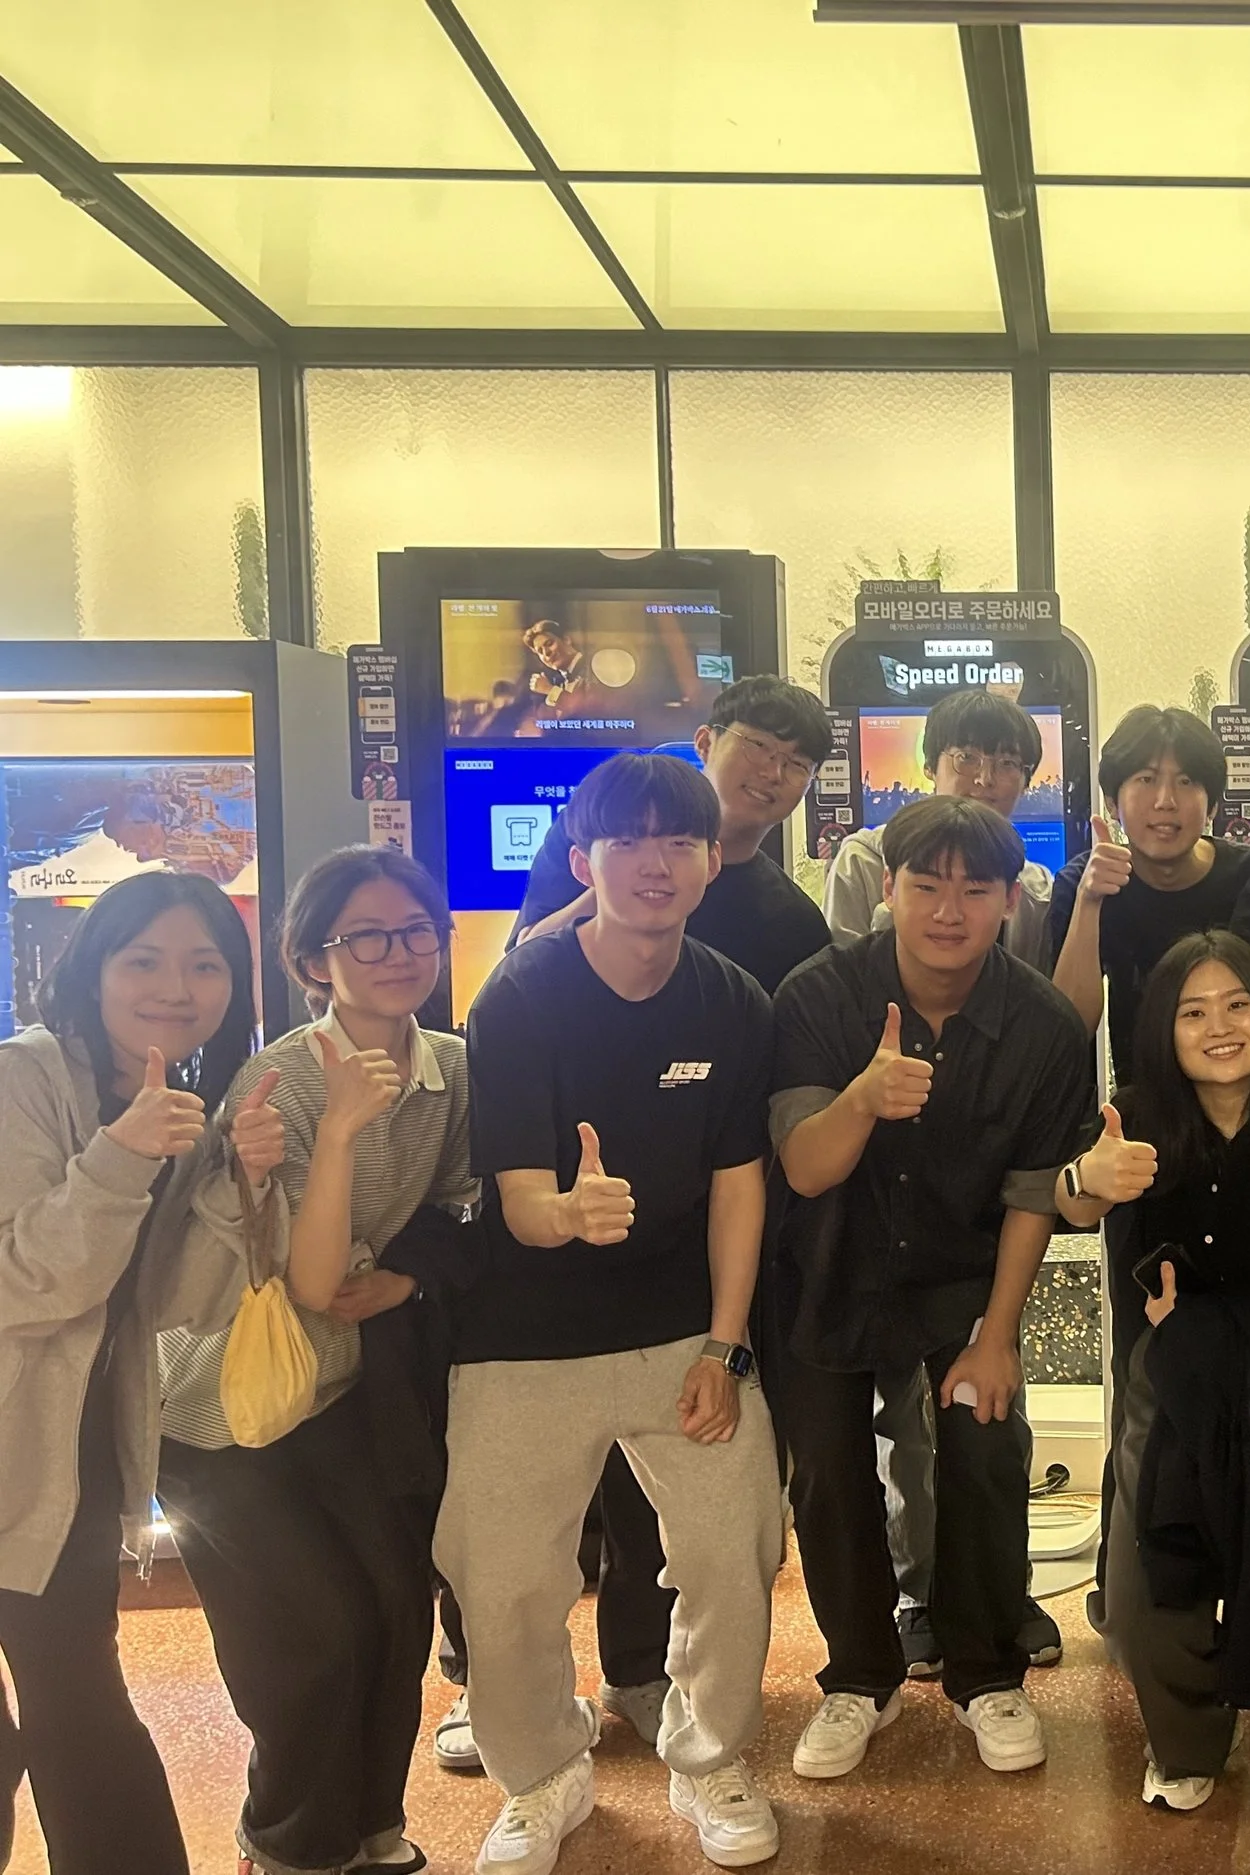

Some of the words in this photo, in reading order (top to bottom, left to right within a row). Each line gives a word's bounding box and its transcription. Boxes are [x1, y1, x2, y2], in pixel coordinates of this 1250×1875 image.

[863, 601, 964, 620] 모바일오더로
[969, 600, 1052, 620] 주문하세요
[926, 643, 991, 654] MEGABOX
[895, 663, 959, 689] Speed
[965, 662, 1023, 684] Order
[534, 785, 567, 798] 무엇을
